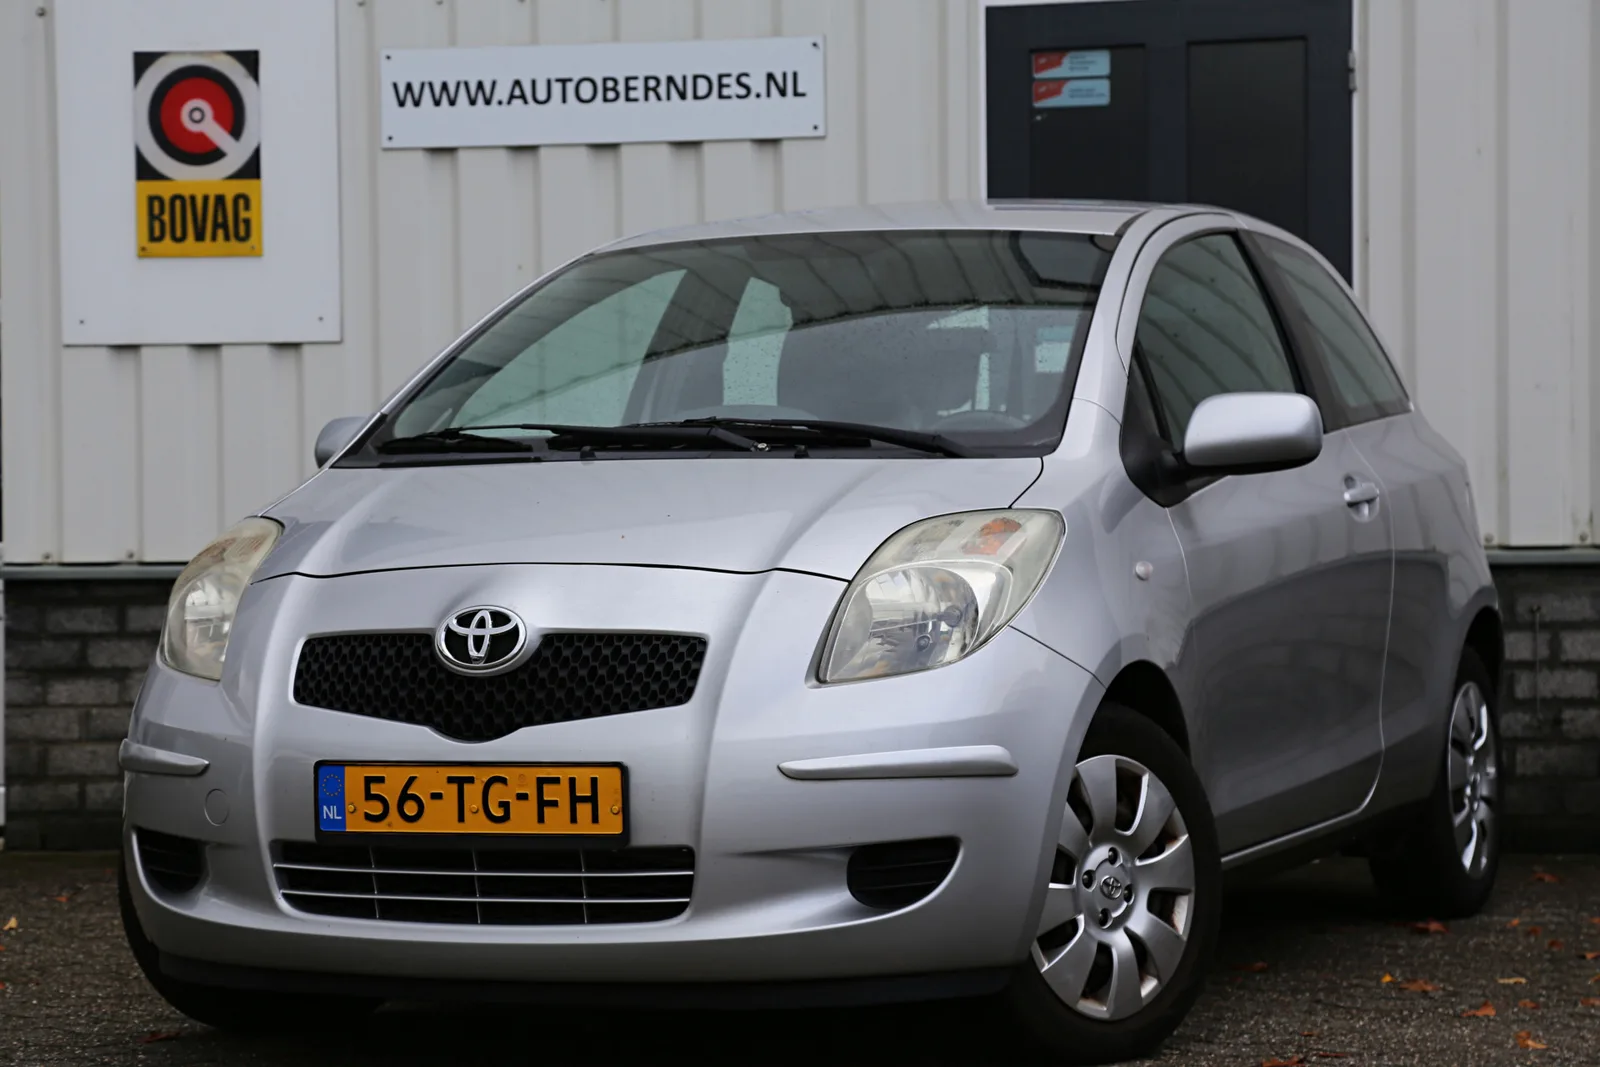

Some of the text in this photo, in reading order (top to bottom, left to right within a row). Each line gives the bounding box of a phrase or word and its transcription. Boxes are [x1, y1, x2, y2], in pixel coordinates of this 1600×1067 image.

[393, 71, 807, 108] WWW.AUTOBERNDES.NL
[146, 193, 252, 244] BOVAG
[323, 805, 343, 820] NL
[363, 775, 600, 824] 56-TG-FH
